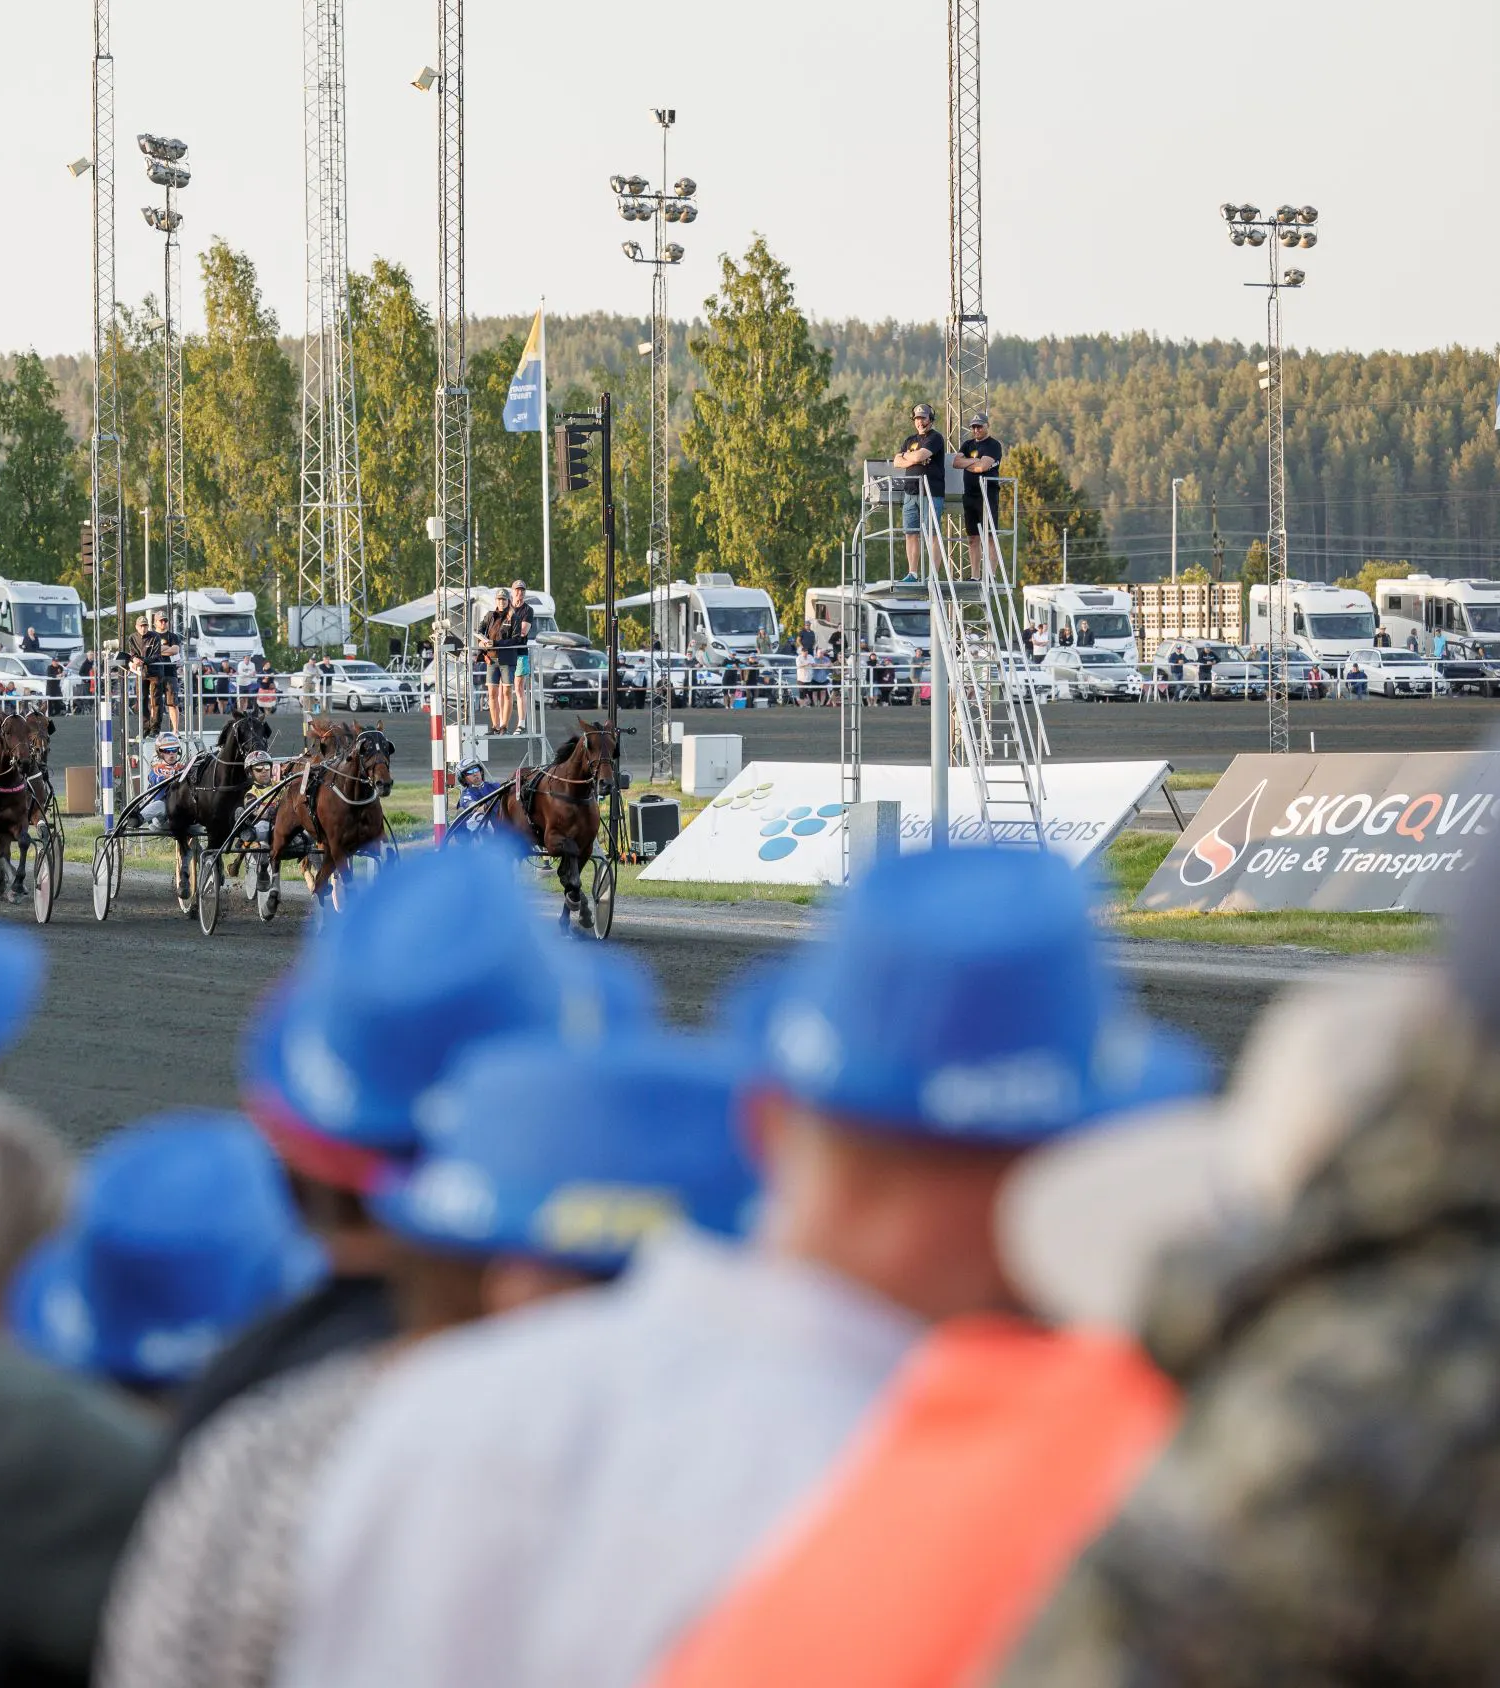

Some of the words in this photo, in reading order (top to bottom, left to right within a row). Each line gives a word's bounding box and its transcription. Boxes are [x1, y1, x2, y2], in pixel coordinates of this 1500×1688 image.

[1247, 848, 1300, 878] Olje
[1302, 846, 1329, 872] &
[1334, 848, 1463, 879] Transport
